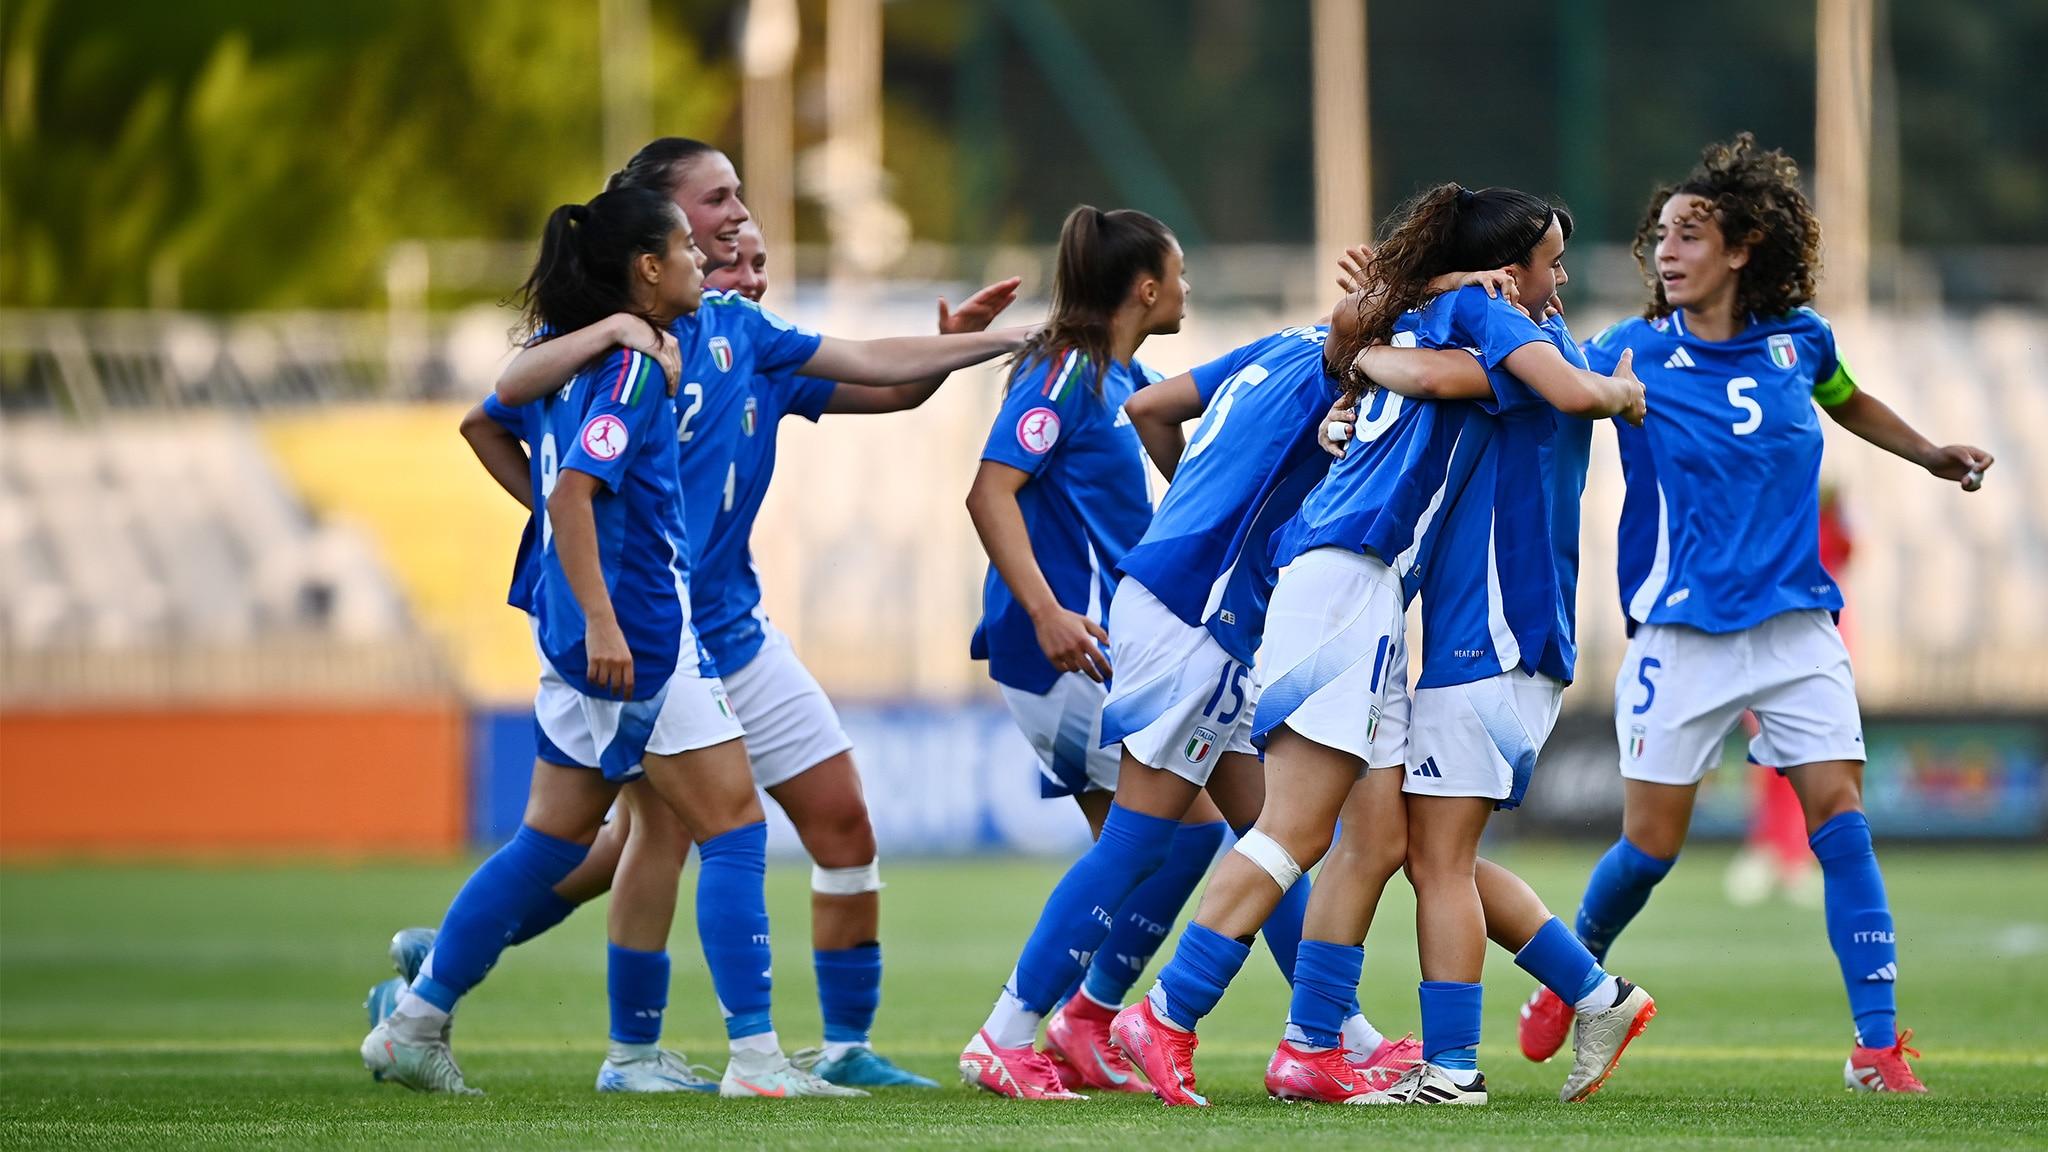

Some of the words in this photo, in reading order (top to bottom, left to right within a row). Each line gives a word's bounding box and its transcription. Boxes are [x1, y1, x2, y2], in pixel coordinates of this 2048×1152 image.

[1727, 376, 1763, 435] 5
[1203, 660, 1249, 725] 15
[1632, 656, 1661, 715] 5
